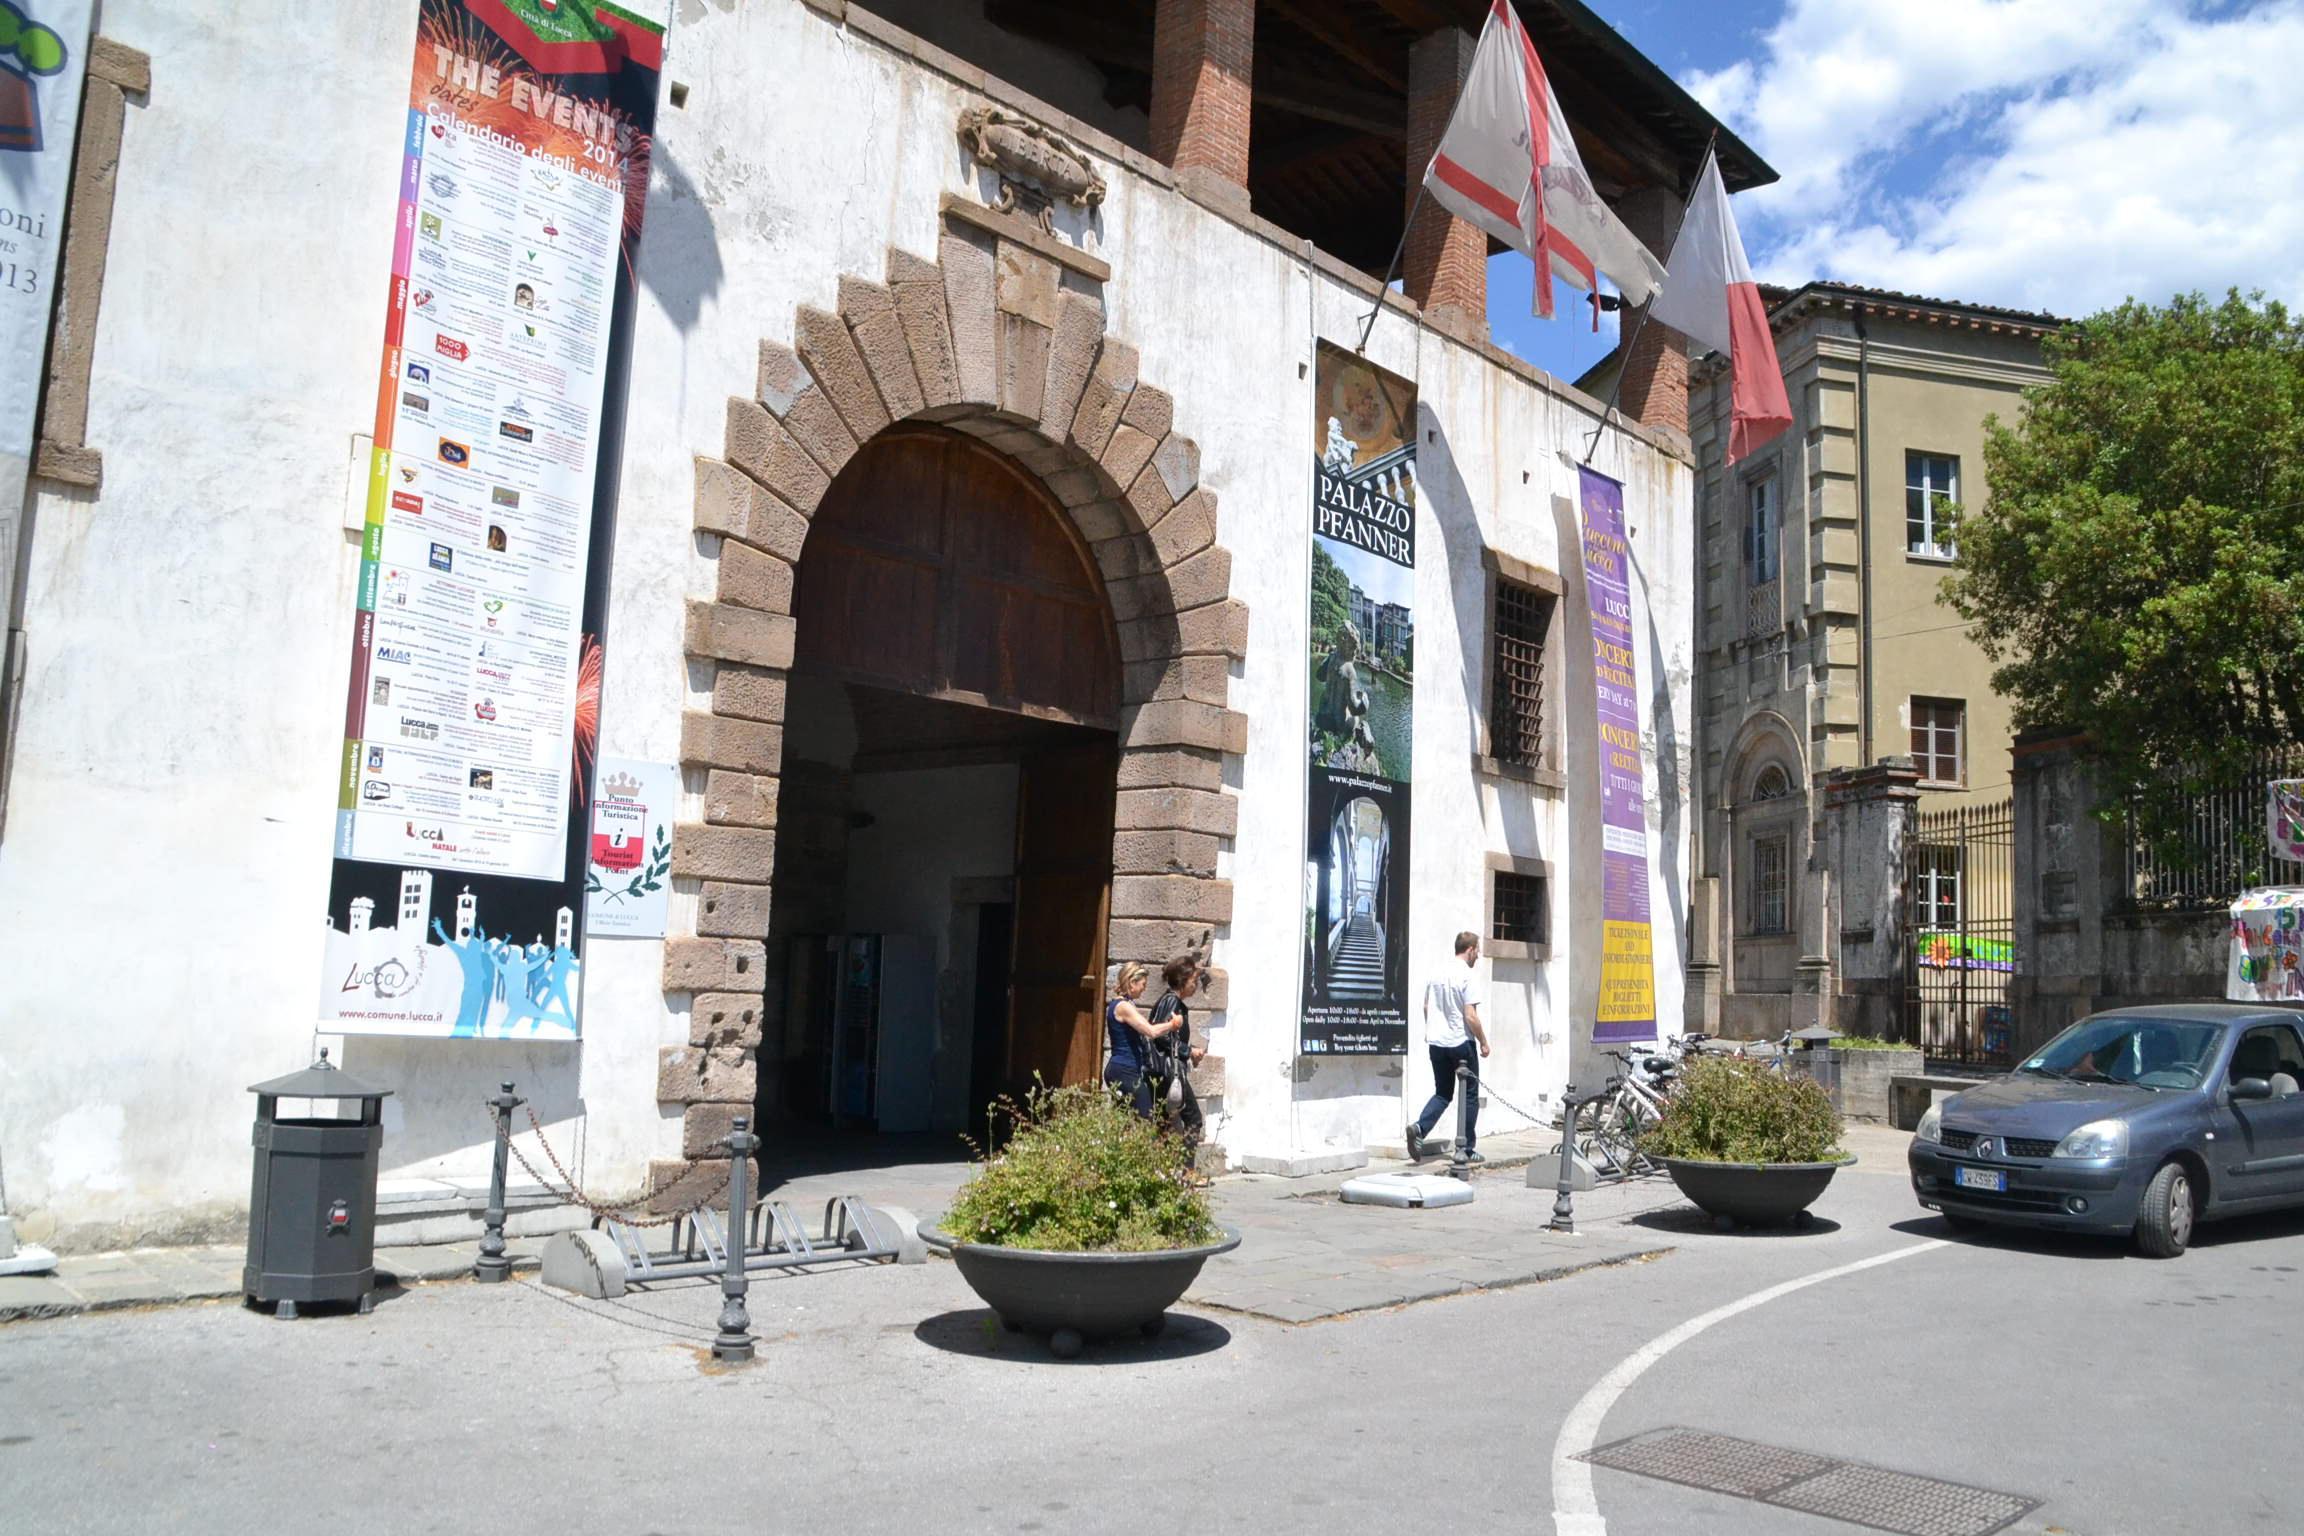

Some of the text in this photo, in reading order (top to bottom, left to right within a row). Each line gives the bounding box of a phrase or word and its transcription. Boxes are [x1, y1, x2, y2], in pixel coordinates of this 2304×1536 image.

[551, 22, 573, 38] Lucca
[430, 81, 479, 112] dates
[433, 43, 501, 99] THE
[511, 77, 636, 154] EVENTS
[412, 114, 424, 148] febbraio
[426, 102, 526, 155] Calendario
[531, 145, 577, 174] degli
[583, 140, 629, 173] 2014
[405, 205, 414, 229] aprile
[0, 262, 37, 294] 13
[396, 279, 406, 310] maggio
[437, 345, 463, 359] MIGLIA
[440, 336, 461, 349] 1000
[389, 350, 399, 379] giugno
[378, 452, 388, 477] luglio
[1320, 475, 1410, 533] PALAZZO
[371, 527, 380, 556] agosto
[1318, 505, 1412, 565] PFANNER
[364, 564, 376, 608] settembre
[1605, 597, 1630, 619] LUCC
[362, 614, 372, 648] ottobre
[377, 647, 411, 661] MIAC
[401, 716, 426, 728] Lucca
[348, 743, 360, 788] novembre
[592, 800, 648, 814] Informazione
[608, 794, 634, 804] Punto
[602, 810, 638, 820] Turistica
[432, 842, 457, 853] NATALE
[615, 828, 623, 846] i
[590, 857, 644, 868] Information
[602, 850, 634, 859] Tourist
[605, 867, 629, 875] Point
[339, 1010, 443, 1022] www.comune.lucca.it
